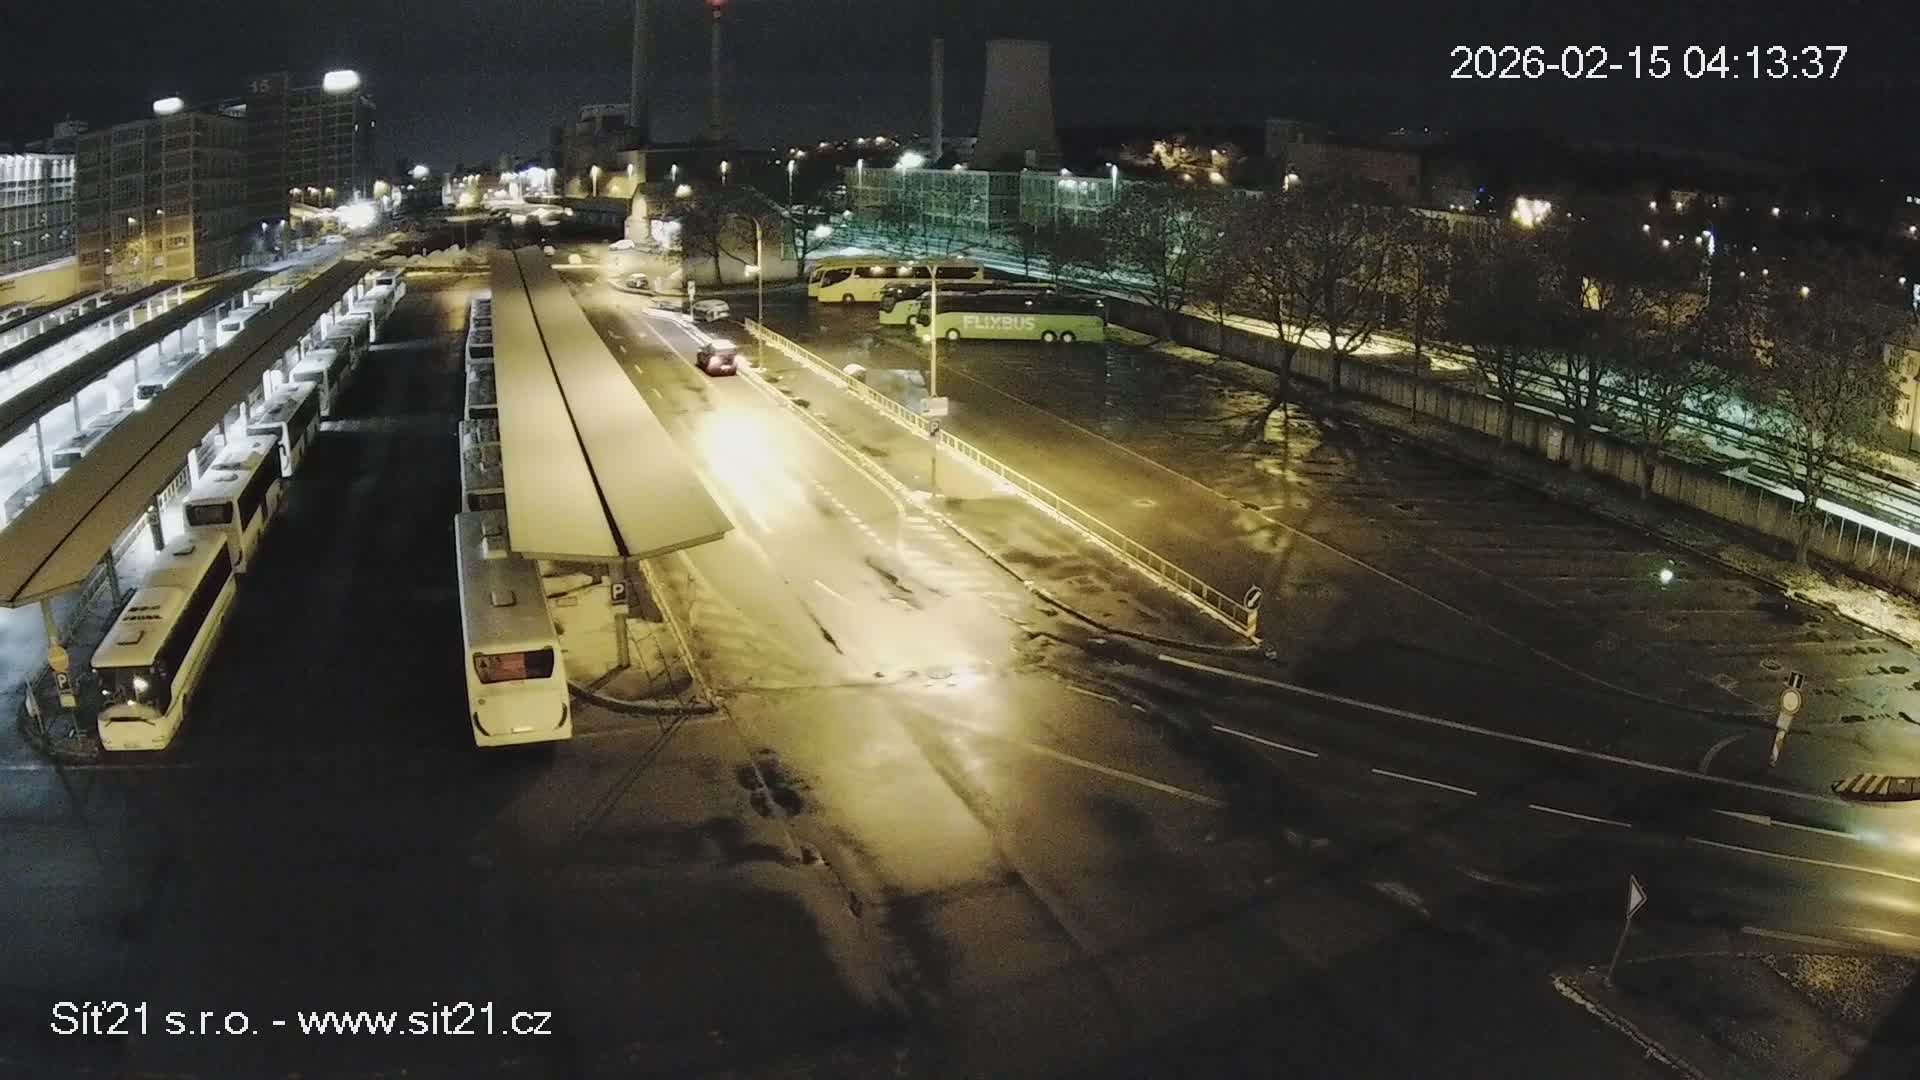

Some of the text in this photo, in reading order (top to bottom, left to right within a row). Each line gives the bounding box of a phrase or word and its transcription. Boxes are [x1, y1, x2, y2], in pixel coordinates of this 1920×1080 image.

[963, 314, 1036, 330] FLIXBUS
[612, 583, 625, 600] P
[56, 673, 67, 689] P
